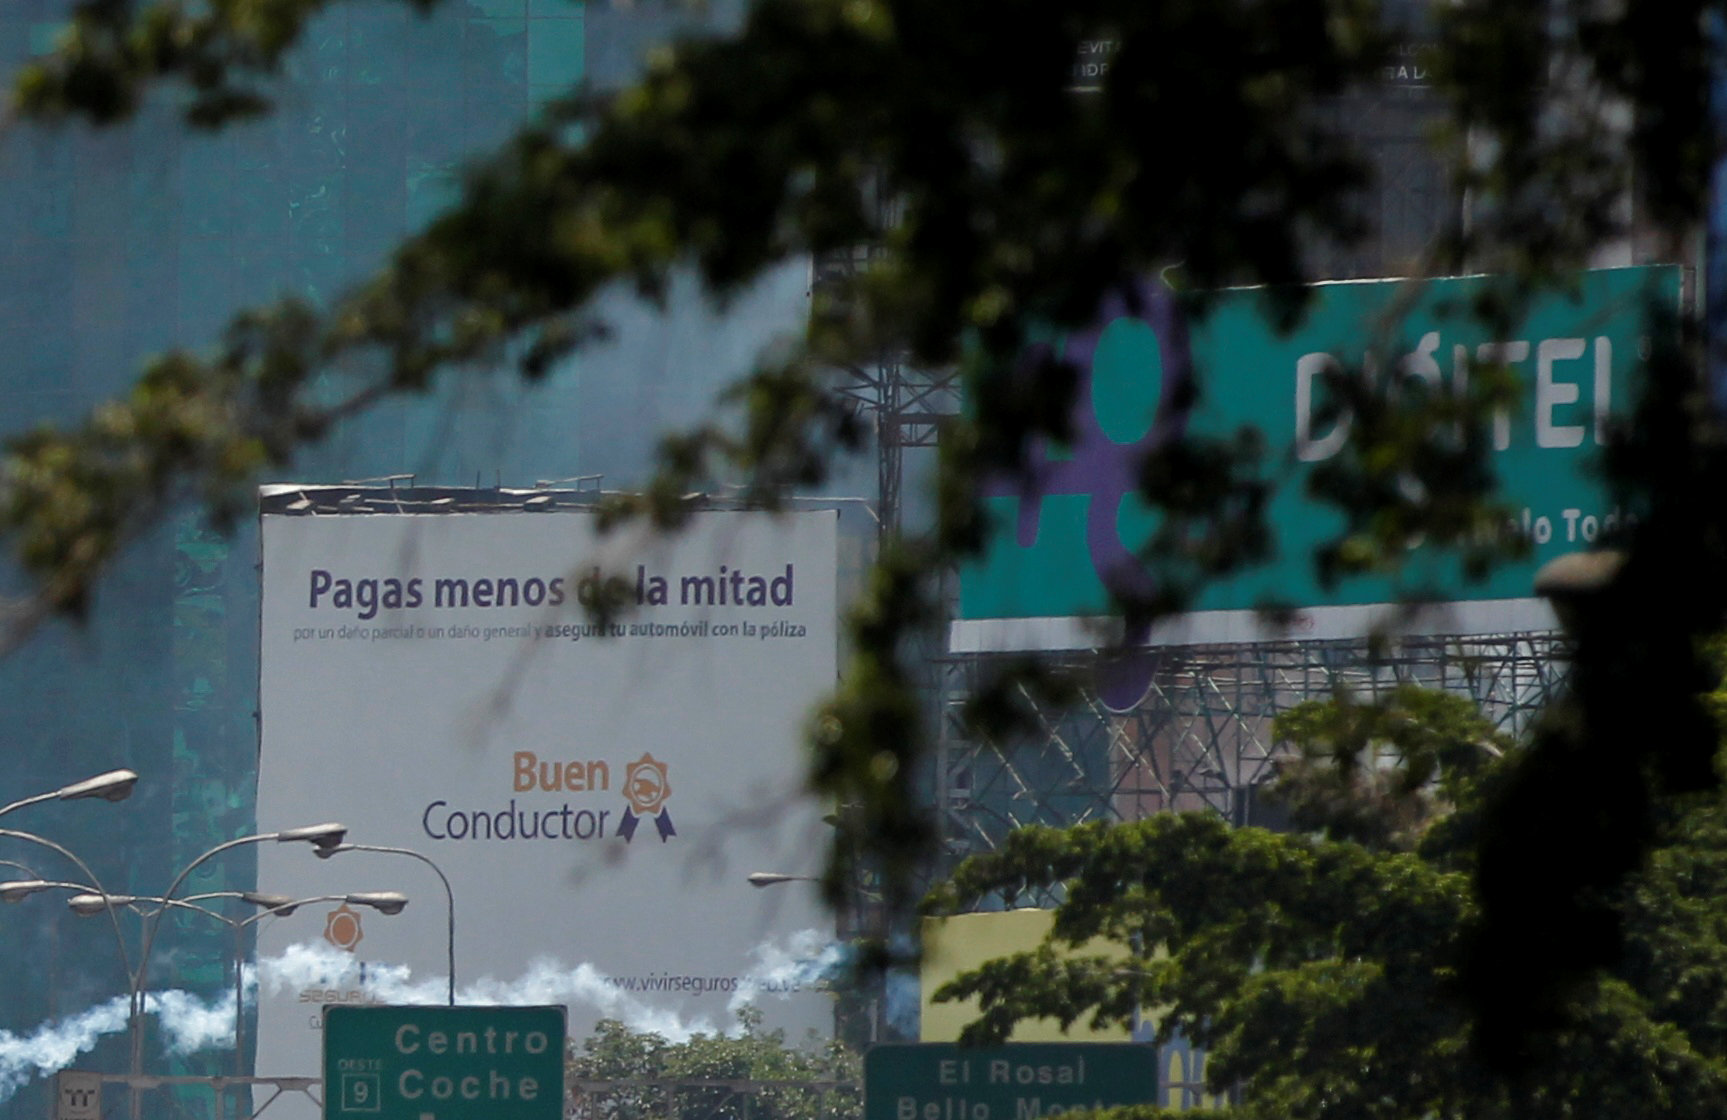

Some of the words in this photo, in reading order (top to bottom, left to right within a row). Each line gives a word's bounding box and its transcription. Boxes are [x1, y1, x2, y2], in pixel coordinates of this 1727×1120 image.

[309, 569, 422, 619] Pagas
[434, 577, 564, 608] menos
[636, 565, 668, 606] la
[681, 563, 794, 607] mitad
[294, 627, 315, 641] por
[319, 627, 334, 640] un
[338, 624, 369, 640] daño
[372, 624, 413, 642] parcial
[428, 627, 444, 640] un
[448, 624, 480, 640] daño
[483, 624, 531, 642] general
[610, 622, 626, 638] tu
[630, 621, 708, 638] automóvil
[712, 624, 738, 637] con
[743, 621, 756, 637] la
[761, 621, 806, 641] póliza
[513, 751, 608, 792] Buen
[423, 800, 610, 841] Conductor
[395, 1024, 548, 1054] Centro
[338, 1059, 383, 1070] OESTE
[940, 1060, 970, 1085] El
[989, 1055, 1085, 1085] Rosal
[354, 1081, 369, 1103] 9
[399, 1069, 539, 1099] Coche
